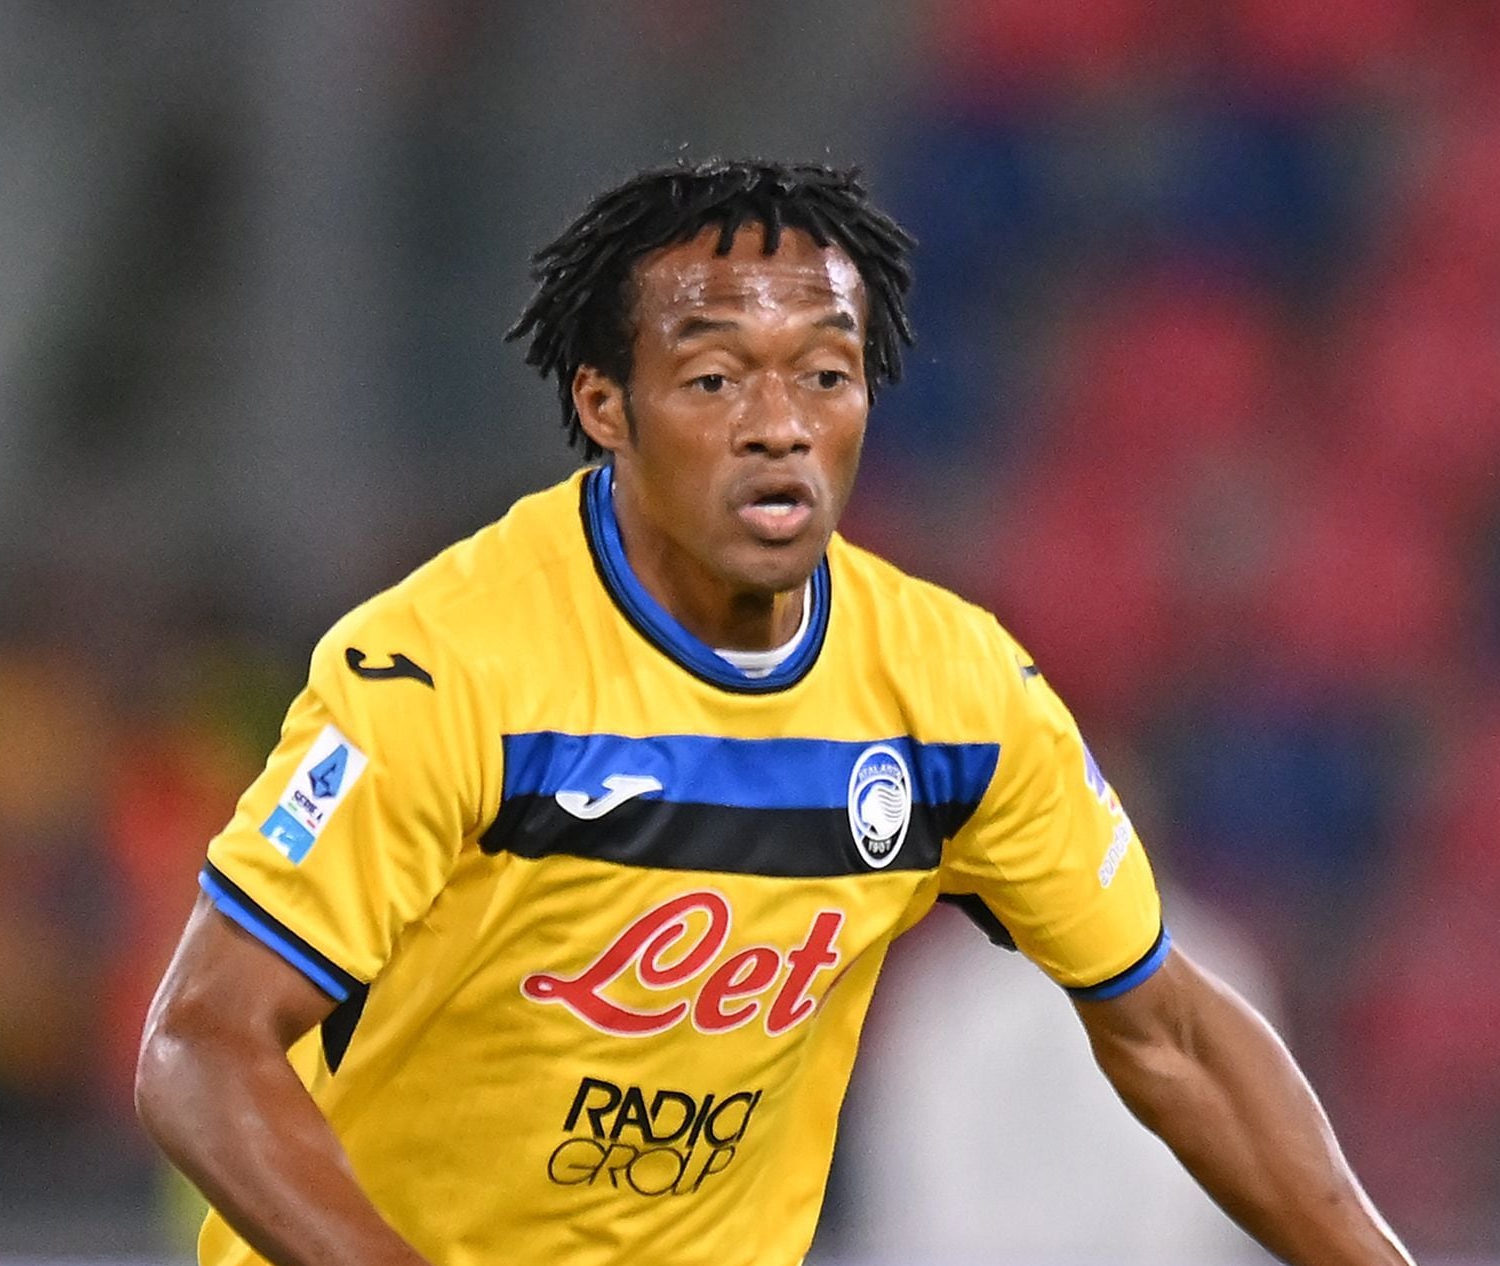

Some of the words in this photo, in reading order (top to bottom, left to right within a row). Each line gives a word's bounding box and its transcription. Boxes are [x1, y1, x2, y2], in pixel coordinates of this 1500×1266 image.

[868, 840, 892, 854] 1907
[563, 1077, 763, 1149] RADICI
[548, 1138, 736, 1196] GROUP
